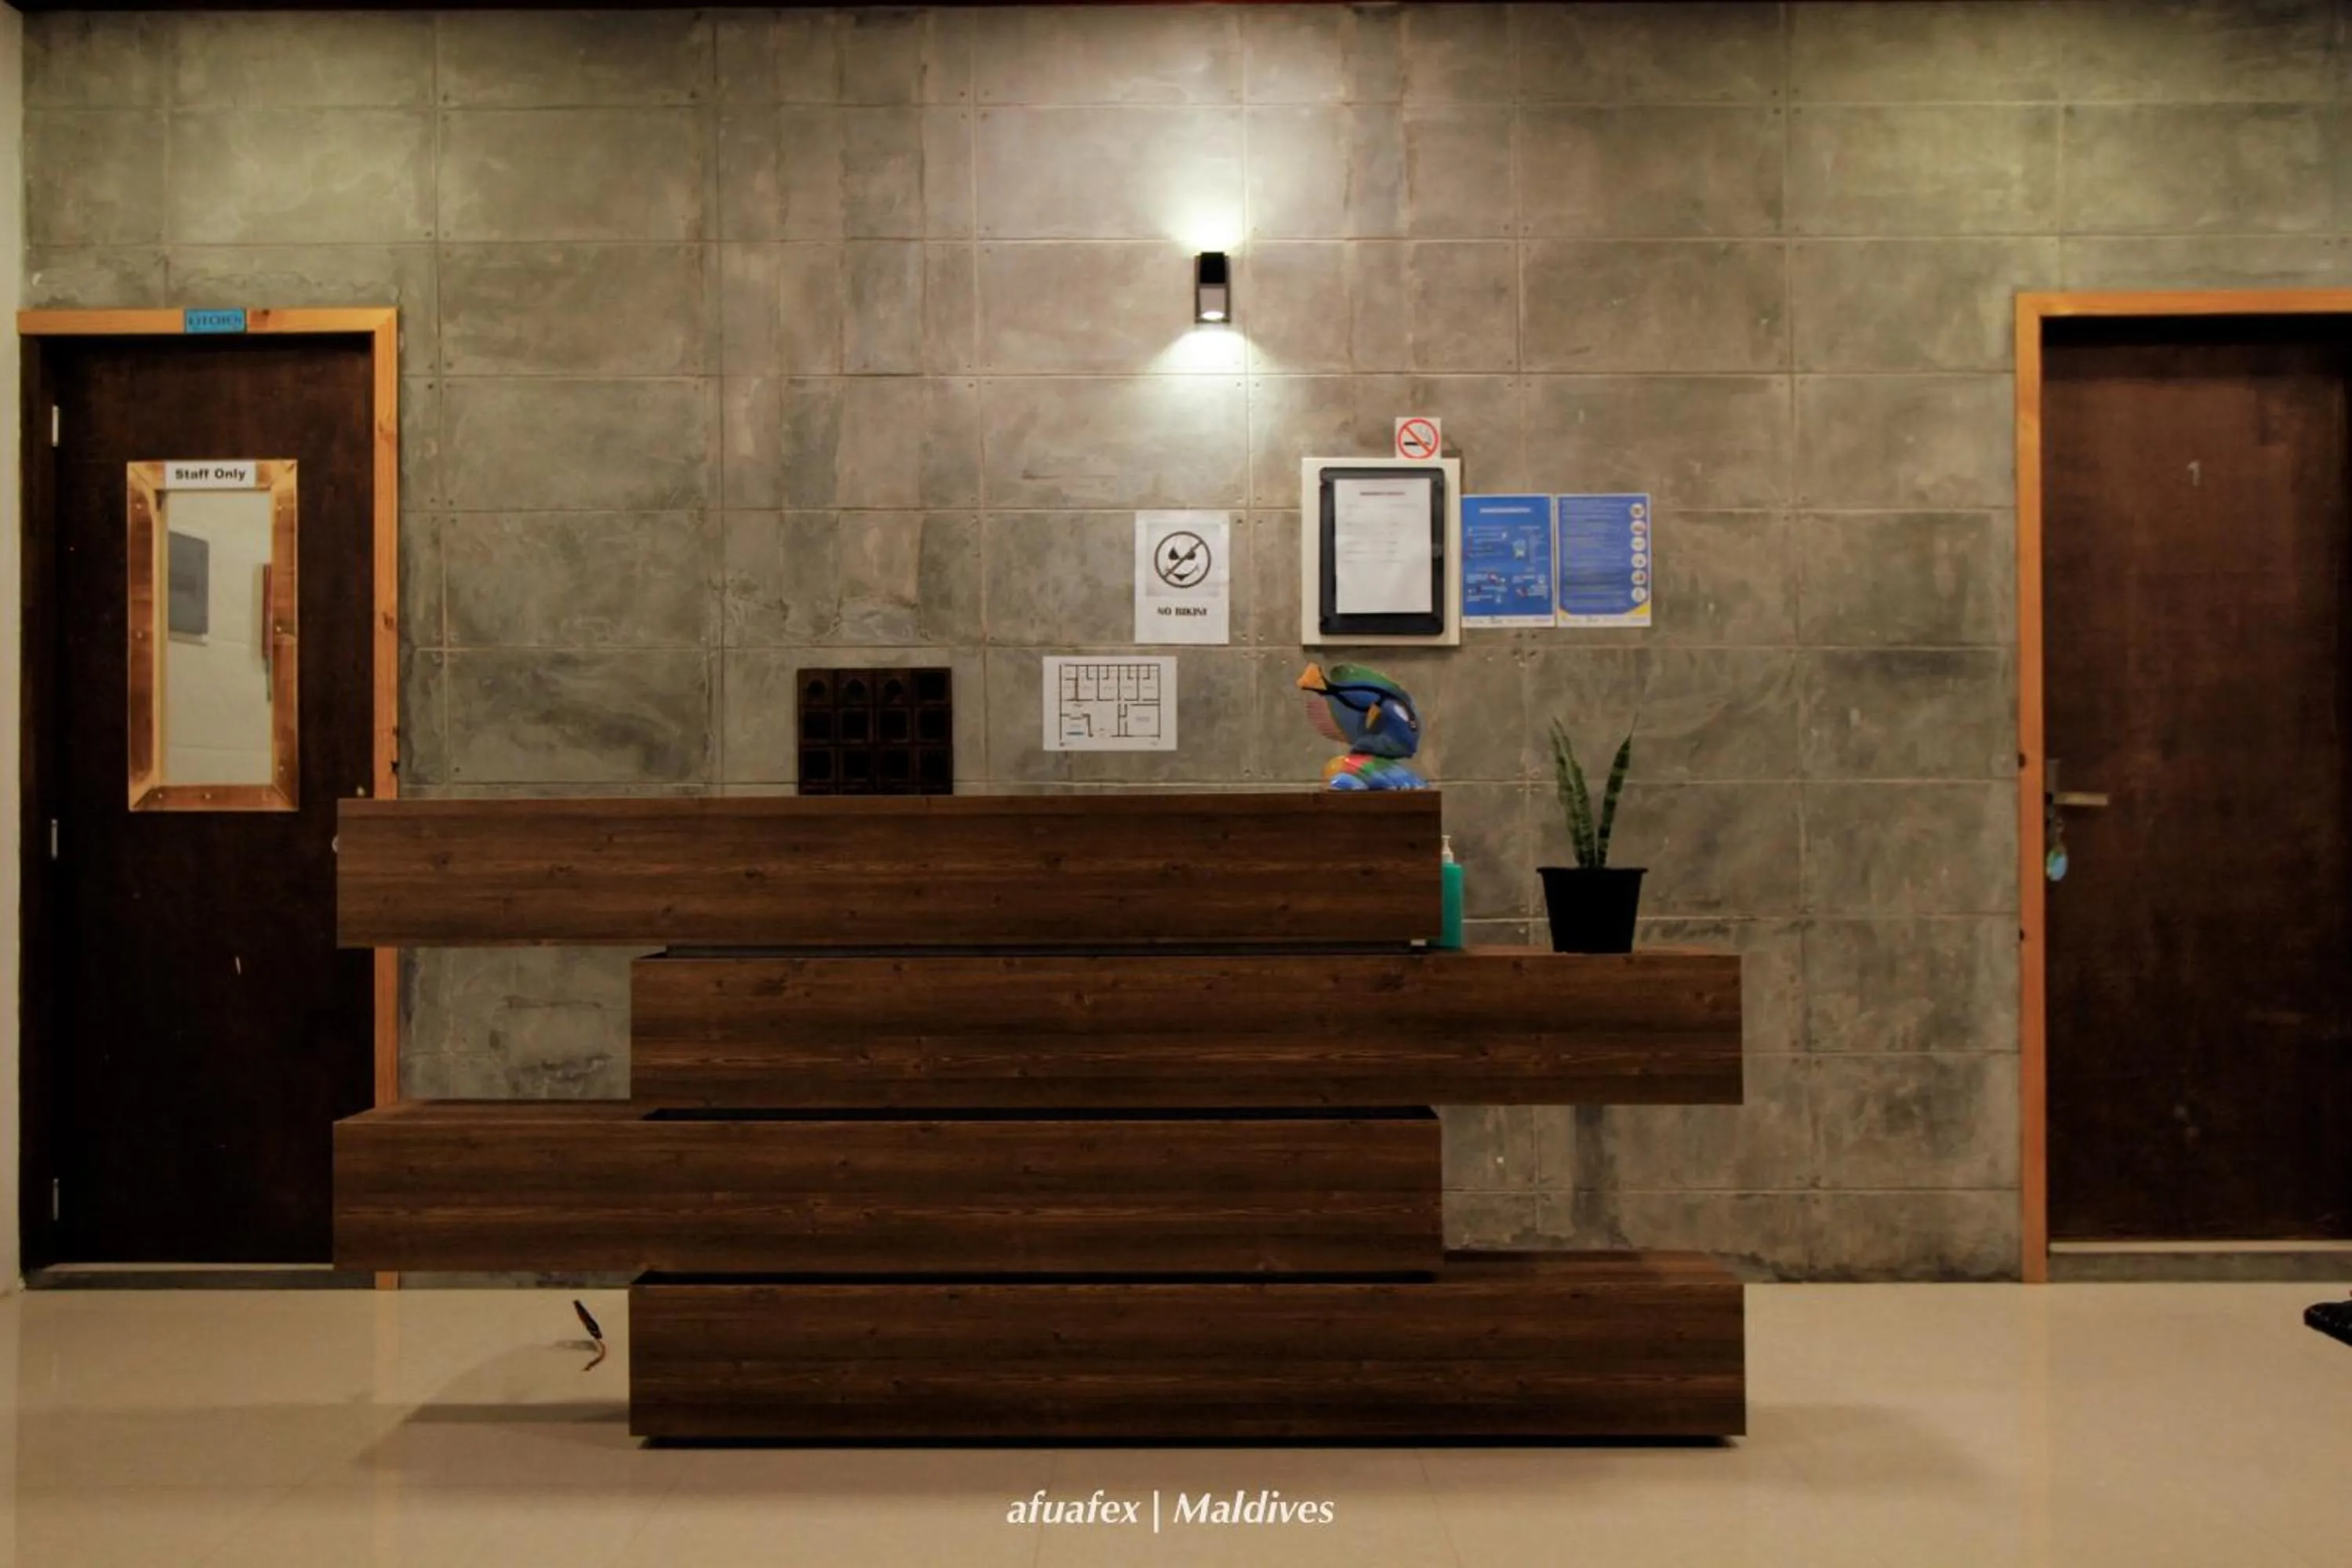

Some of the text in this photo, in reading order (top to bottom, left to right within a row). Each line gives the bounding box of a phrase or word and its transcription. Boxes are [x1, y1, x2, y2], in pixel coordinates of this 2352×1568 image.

[175, 468, 246, 481] Staff Only
[1156, 607, 1207, 616] NO BIKINI
